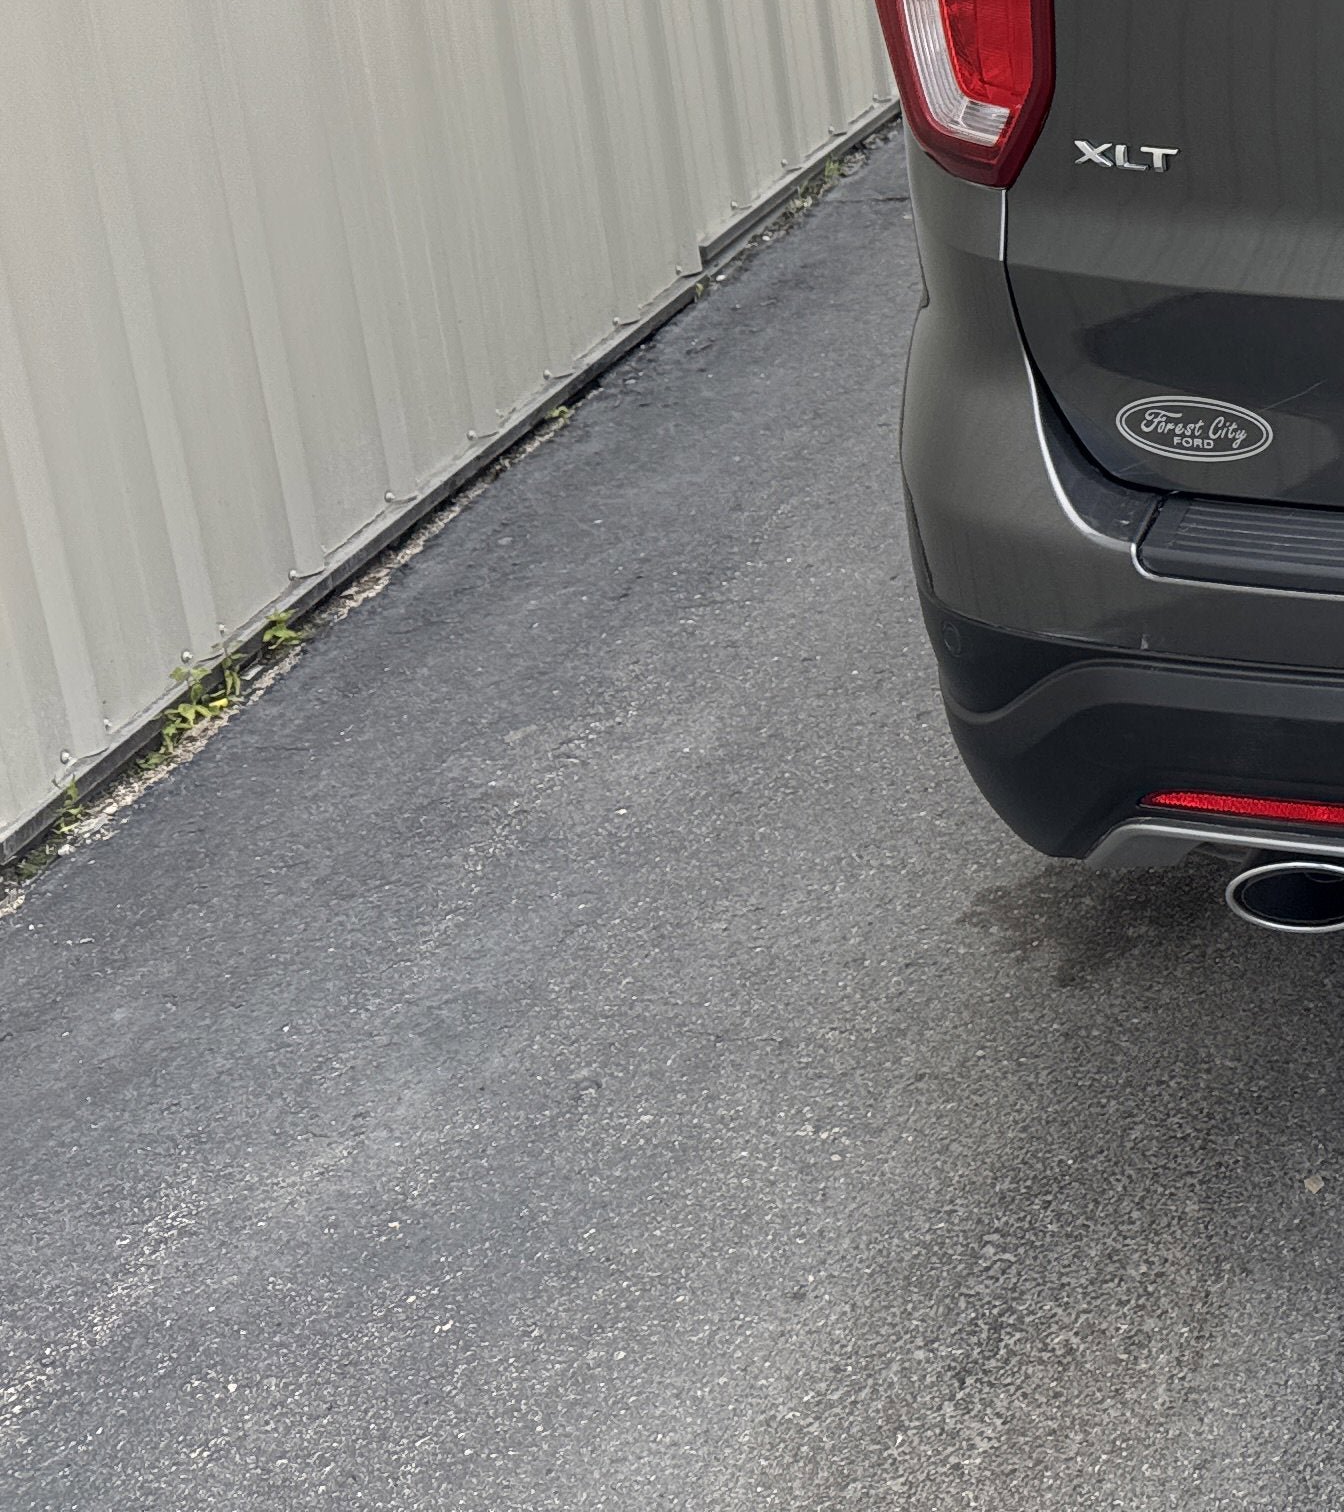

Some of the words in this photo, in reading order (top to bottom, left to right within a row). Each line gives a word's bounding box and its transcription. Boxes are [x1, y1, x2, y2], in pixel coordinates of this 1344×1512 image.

[1074, 140, 1180, 172] XLT
[1140, 409, 1204, 437] Forest
[1208, 416, 1248, 449] City
[1173, 436, 1215, 450] FORD
